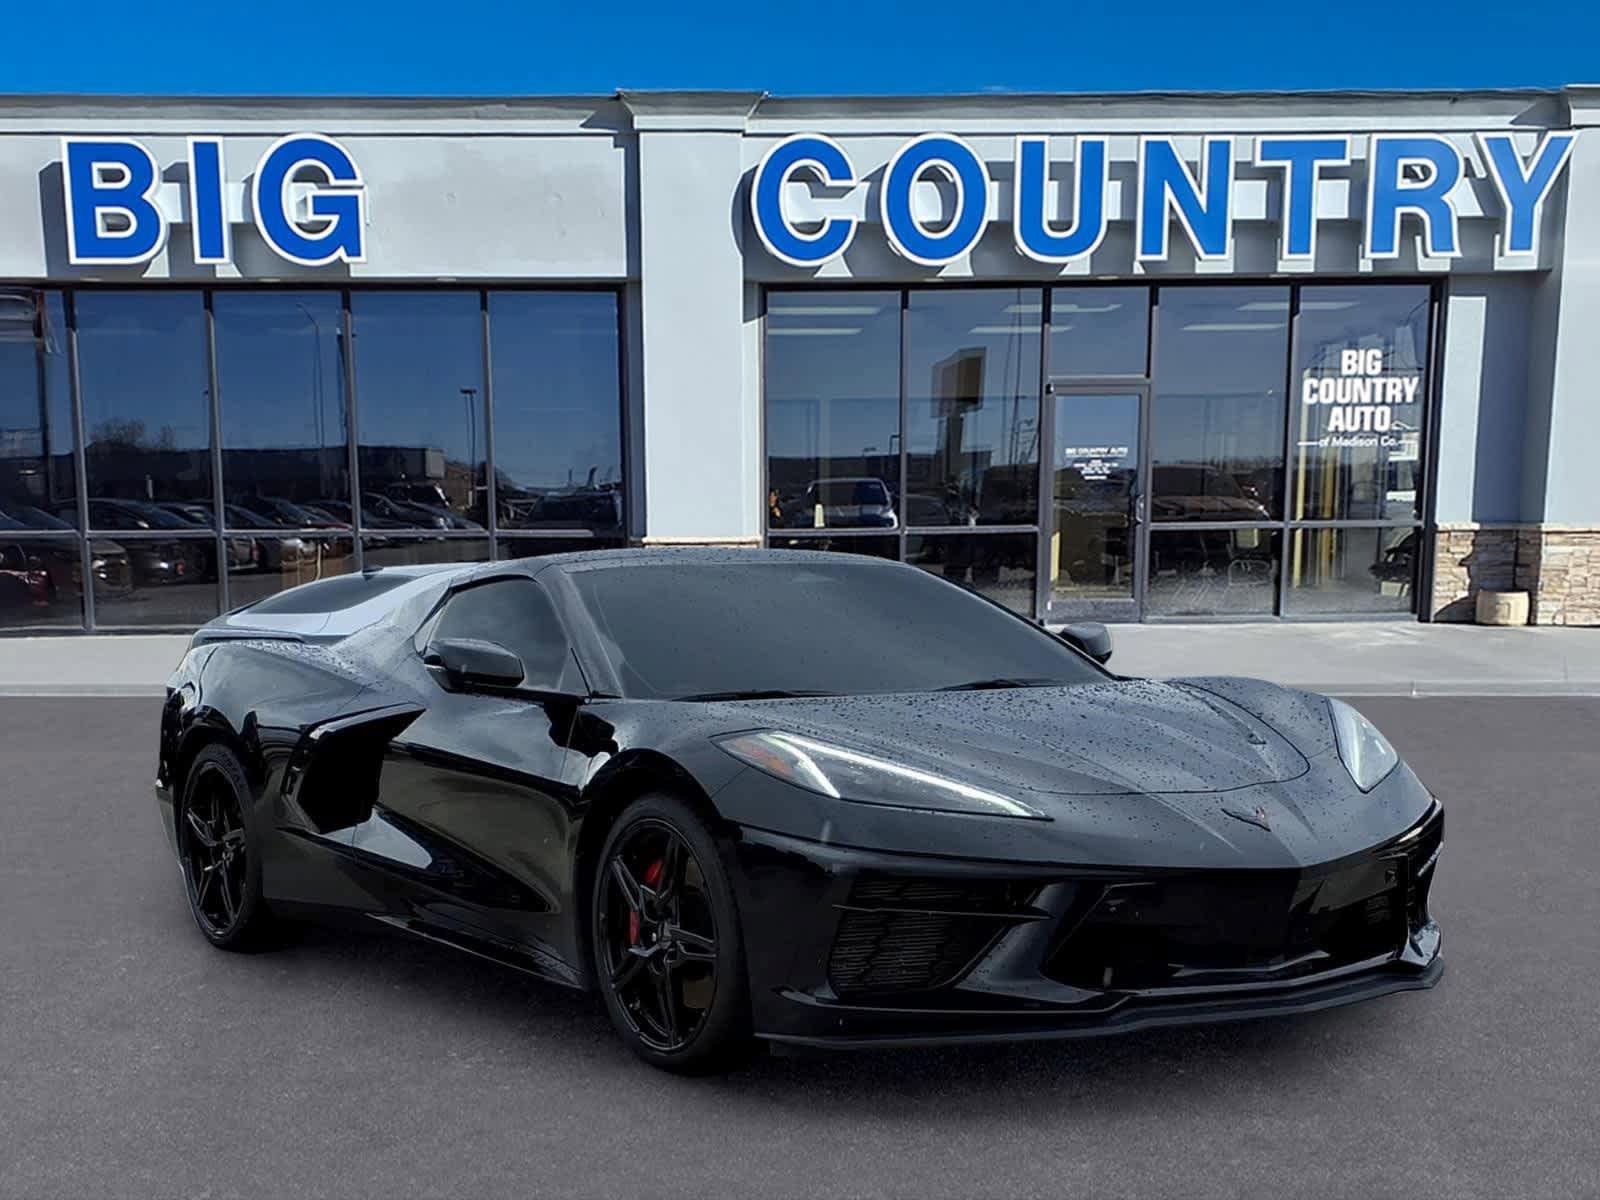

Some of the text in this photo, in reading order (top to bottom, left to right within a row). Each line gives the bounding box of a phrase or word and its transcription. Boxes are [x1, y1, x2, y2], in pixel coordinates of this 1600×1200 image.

[60, 131, 1576, 267] BIG COUNTRY
[1341, 349, 1383, 375] BIG
[1303, 377, 1419, 404] COUNTRY
[1328, 406, 1391, 432] AUTO
[1319, 436, 1329, 447] of
[1331, 436, 1378, 447] Madison
